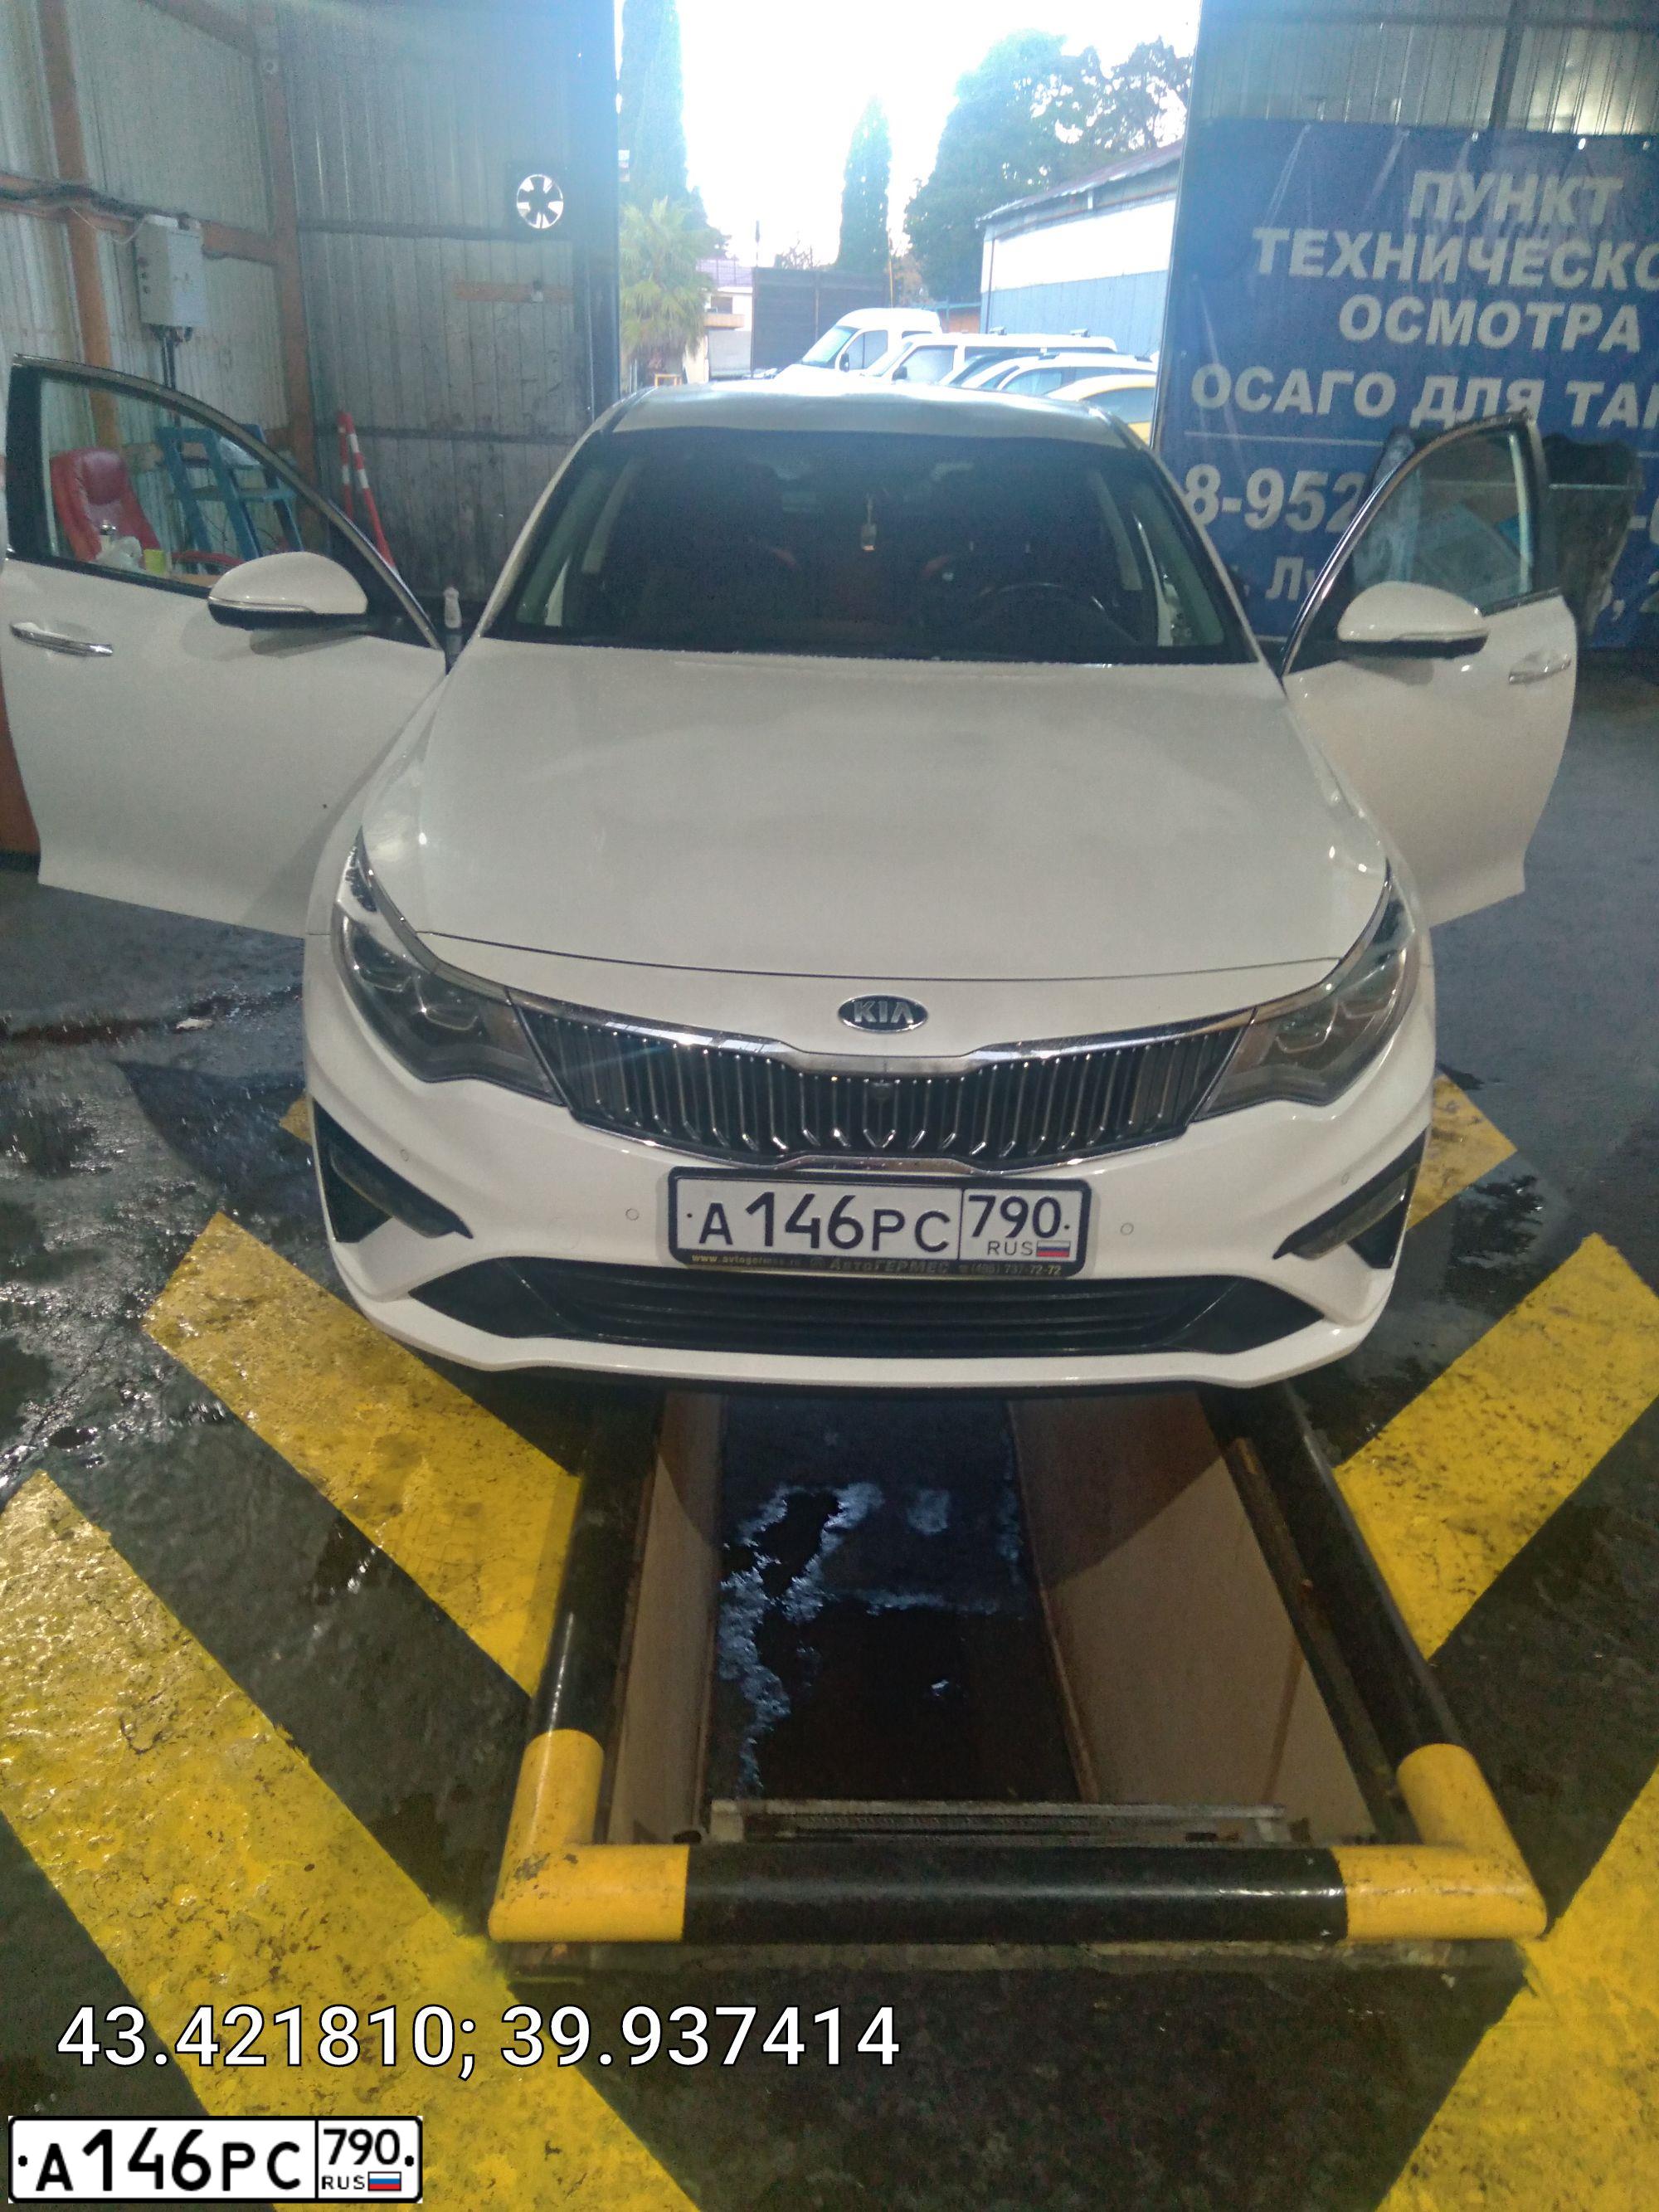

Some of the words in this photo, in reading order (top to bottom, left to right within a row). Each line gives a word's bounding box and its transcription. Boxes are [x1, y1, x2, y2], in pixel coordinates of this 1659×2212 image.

[1408, 169, 1625, 227] ПУНКТ
[1339, 294, 1641, 353] ОСМОТРА
[1191, 363, 1397, 418] ОСАГО
[1412, 375, 1545, 430] ДЛЯ
[853, 1000, 914, 1024] KIA
[698, 1191, 951, 1253] А146РС
[968, 1194, 1062, 1239] 790
[987, 1240, 1034, 1256] RUS
